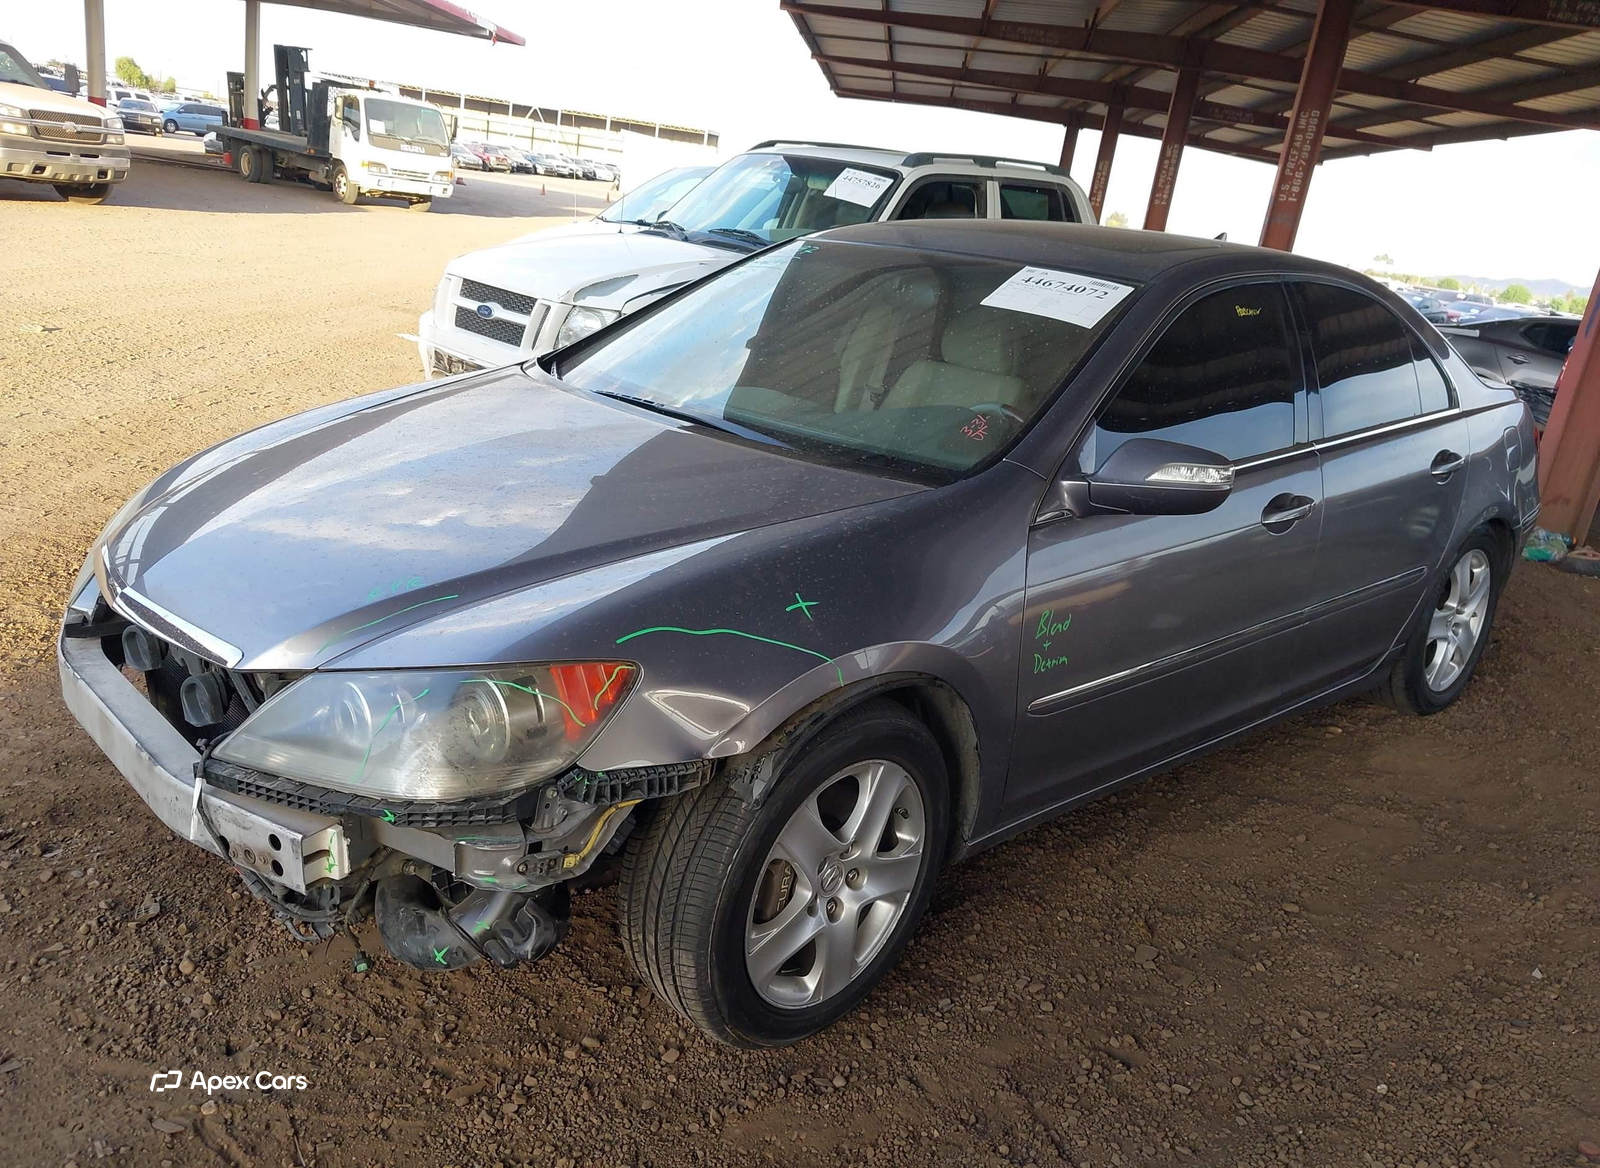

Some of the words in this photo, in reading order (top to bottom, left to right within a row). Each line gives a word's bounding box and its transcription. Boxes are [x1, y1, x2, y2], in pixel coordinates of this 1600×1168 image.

[401, 144, 425, 154] ISUZU
[1285, 134, 1303, 176] PREFAB
[1288, 109, 1320, 202] 1-866-799-0969
[843, 175, 881, 189] 44757826
[1158, 159, 1170, 188] PREFAB
[1020, 275, 1110, 300] 44674072
[1034, 608, 1072, 640] Blend
[776, 865, 791, 912] CURA
